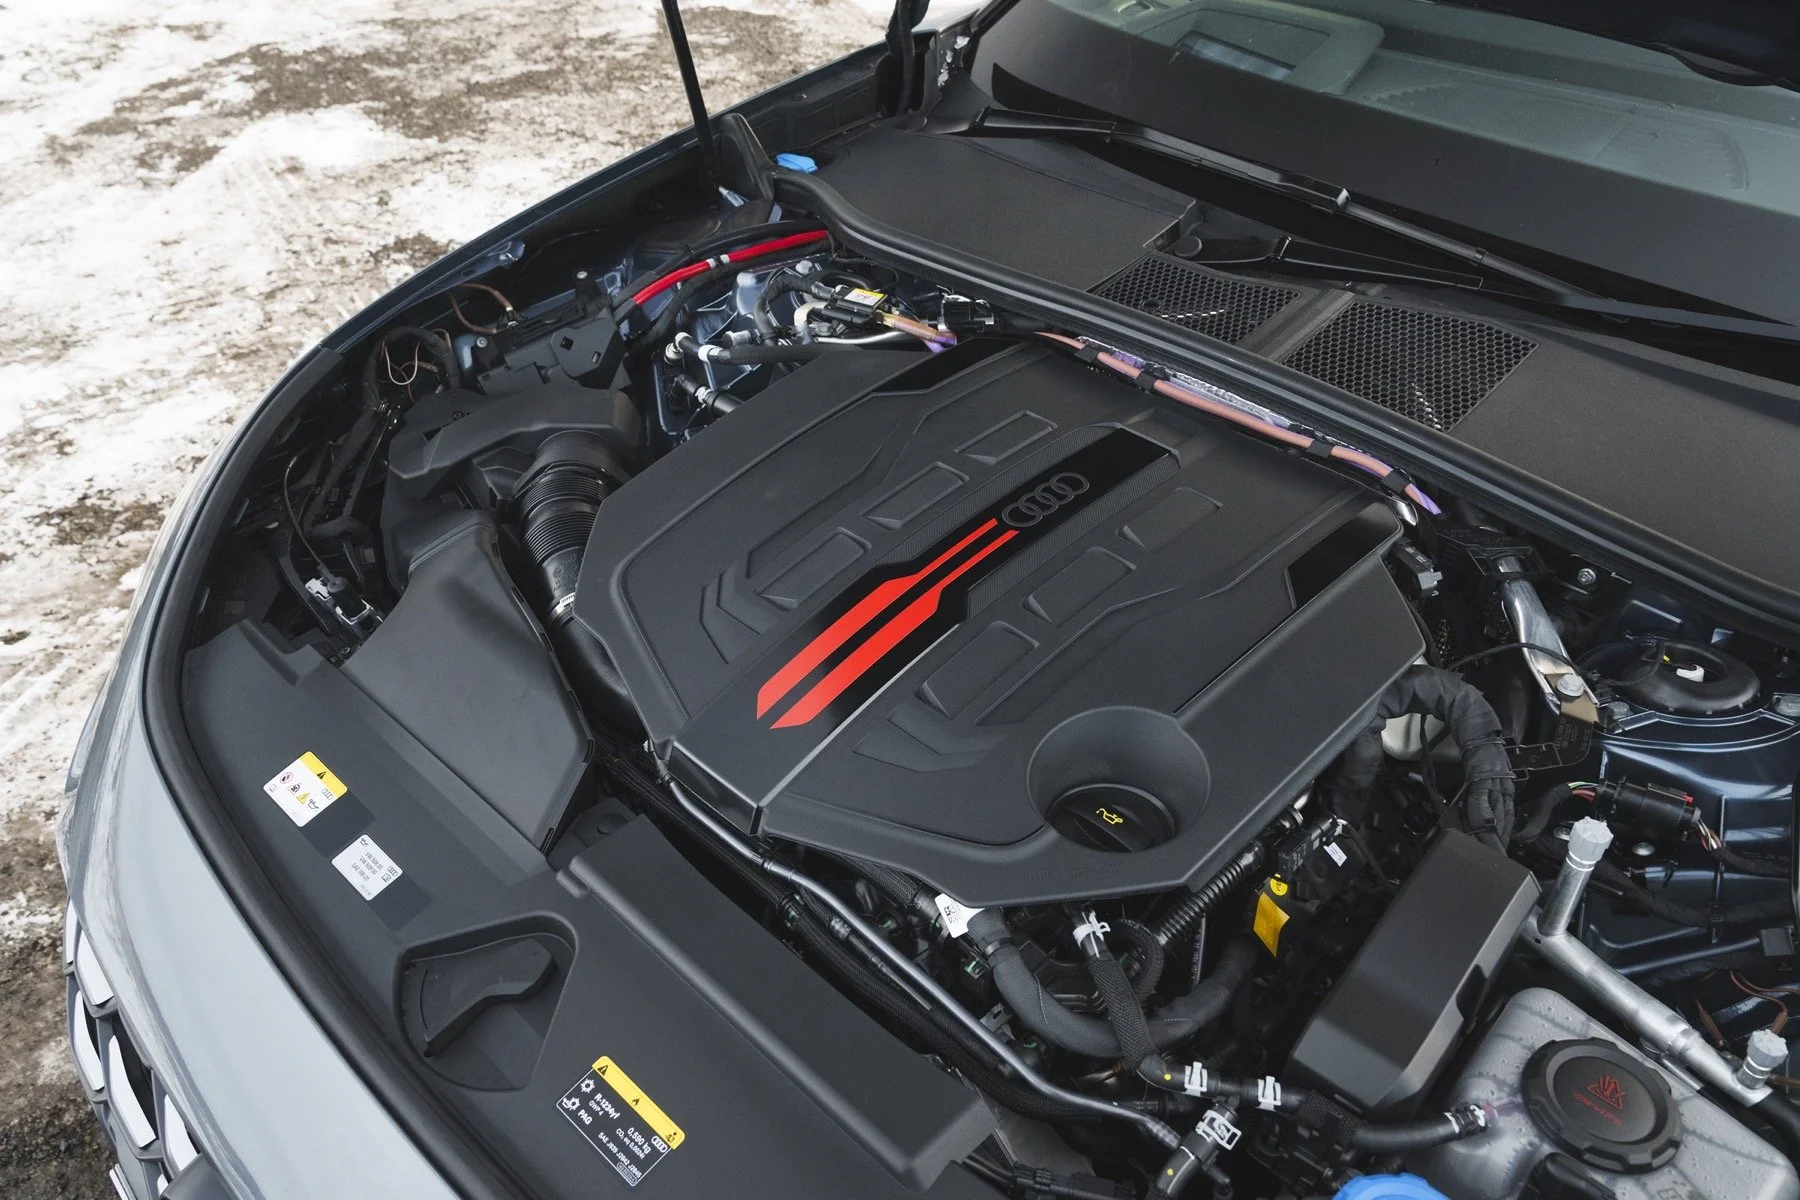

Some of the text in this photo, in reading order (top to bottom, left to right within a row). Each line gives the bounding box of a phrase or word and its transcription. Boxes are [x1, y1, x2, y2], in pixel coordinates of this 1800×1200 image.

[577, 1109, 593, 1125] PAG
[594, 1093, 621, 1120] R-1234yf
[598, 1131, 609, 1144] SAE
[627, 1127, 652, 1155] 0,590 kg
